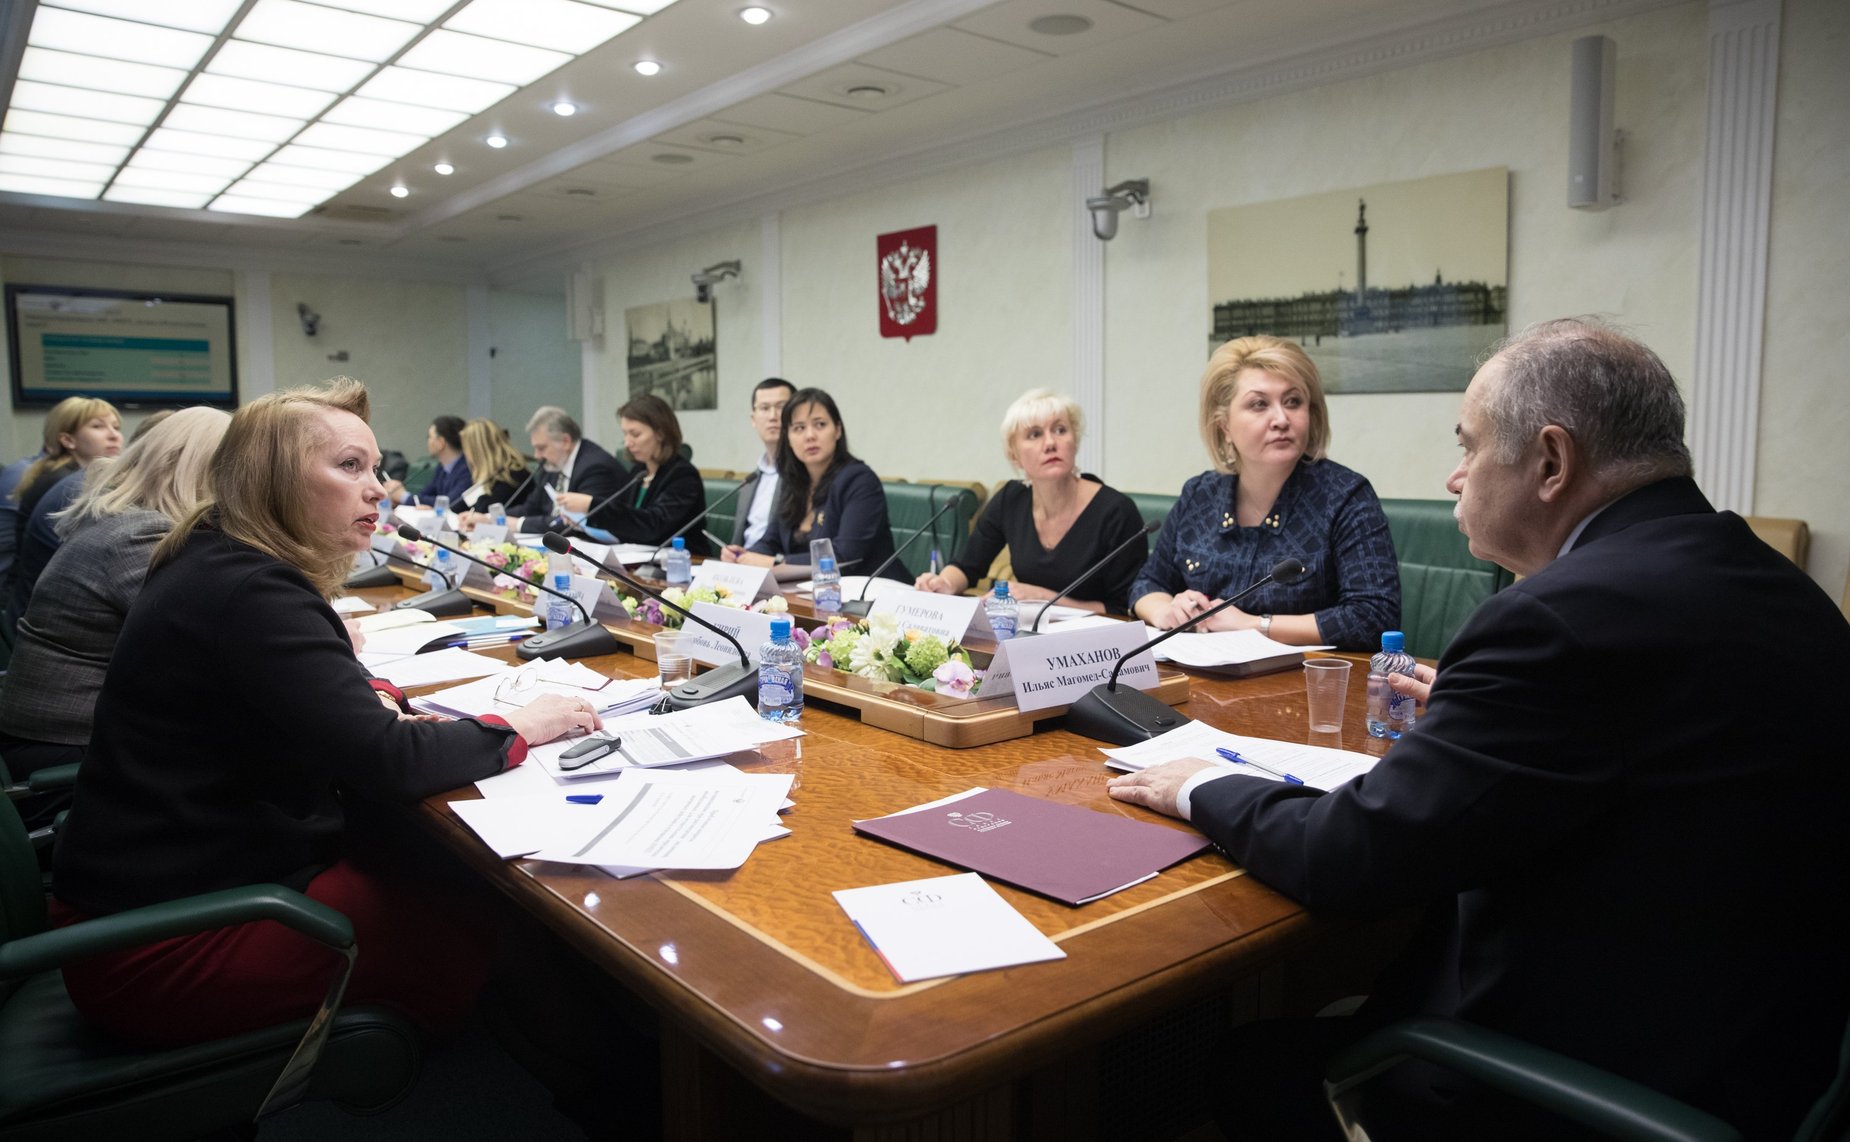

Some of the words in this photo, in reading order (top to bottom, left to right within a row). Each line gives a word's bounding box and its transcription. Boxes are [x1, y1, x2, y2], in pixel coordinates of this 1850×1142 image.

[896, 604, 944, 621] ГУМЕРОВА
[1046, 647, 1121, 671] УМАХАНОВ
[1022, 680, 1055, 694] Ильяс
[1056, 663, 1151, 688] Магомед-Саамович
